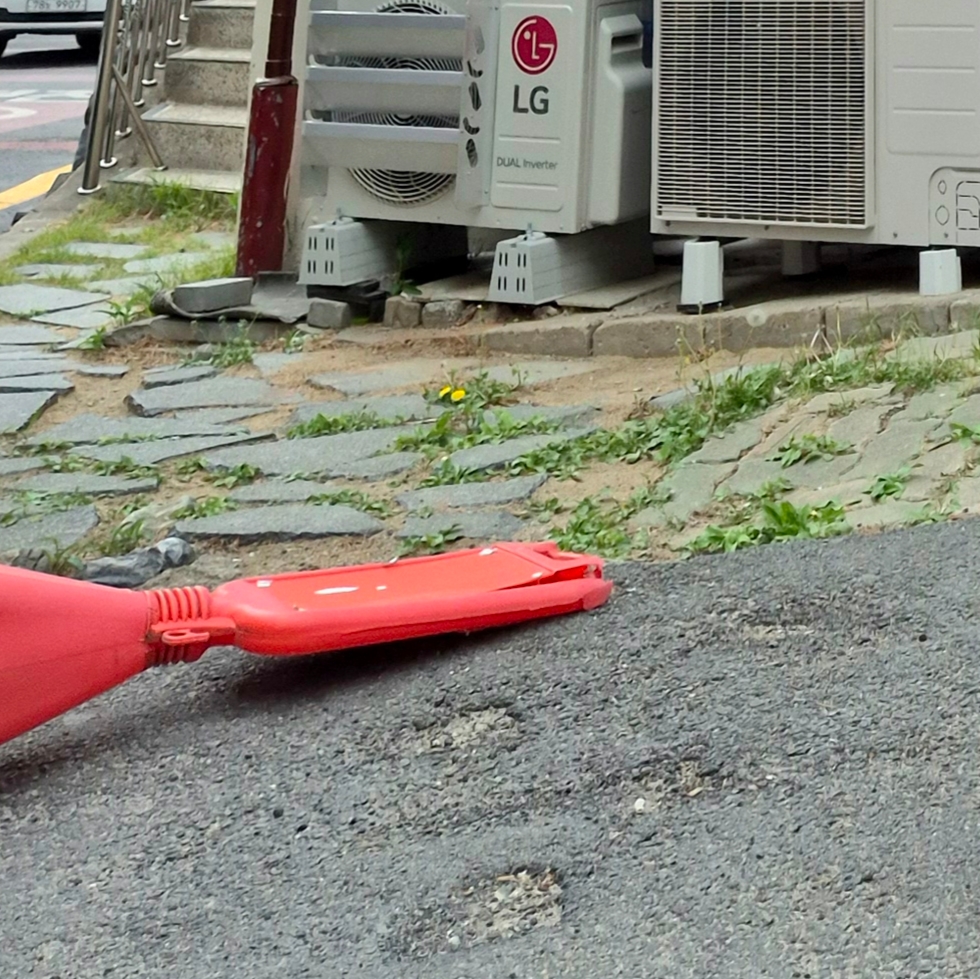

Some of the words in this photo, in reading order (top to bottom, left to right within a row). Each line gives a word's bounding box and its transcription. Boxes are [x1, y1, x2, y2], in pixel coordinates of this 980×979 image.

[512, 83, 550, 115] LG
[496, 156, 522, 169] DUAL
[523, 158, 559, 171] Inverter
